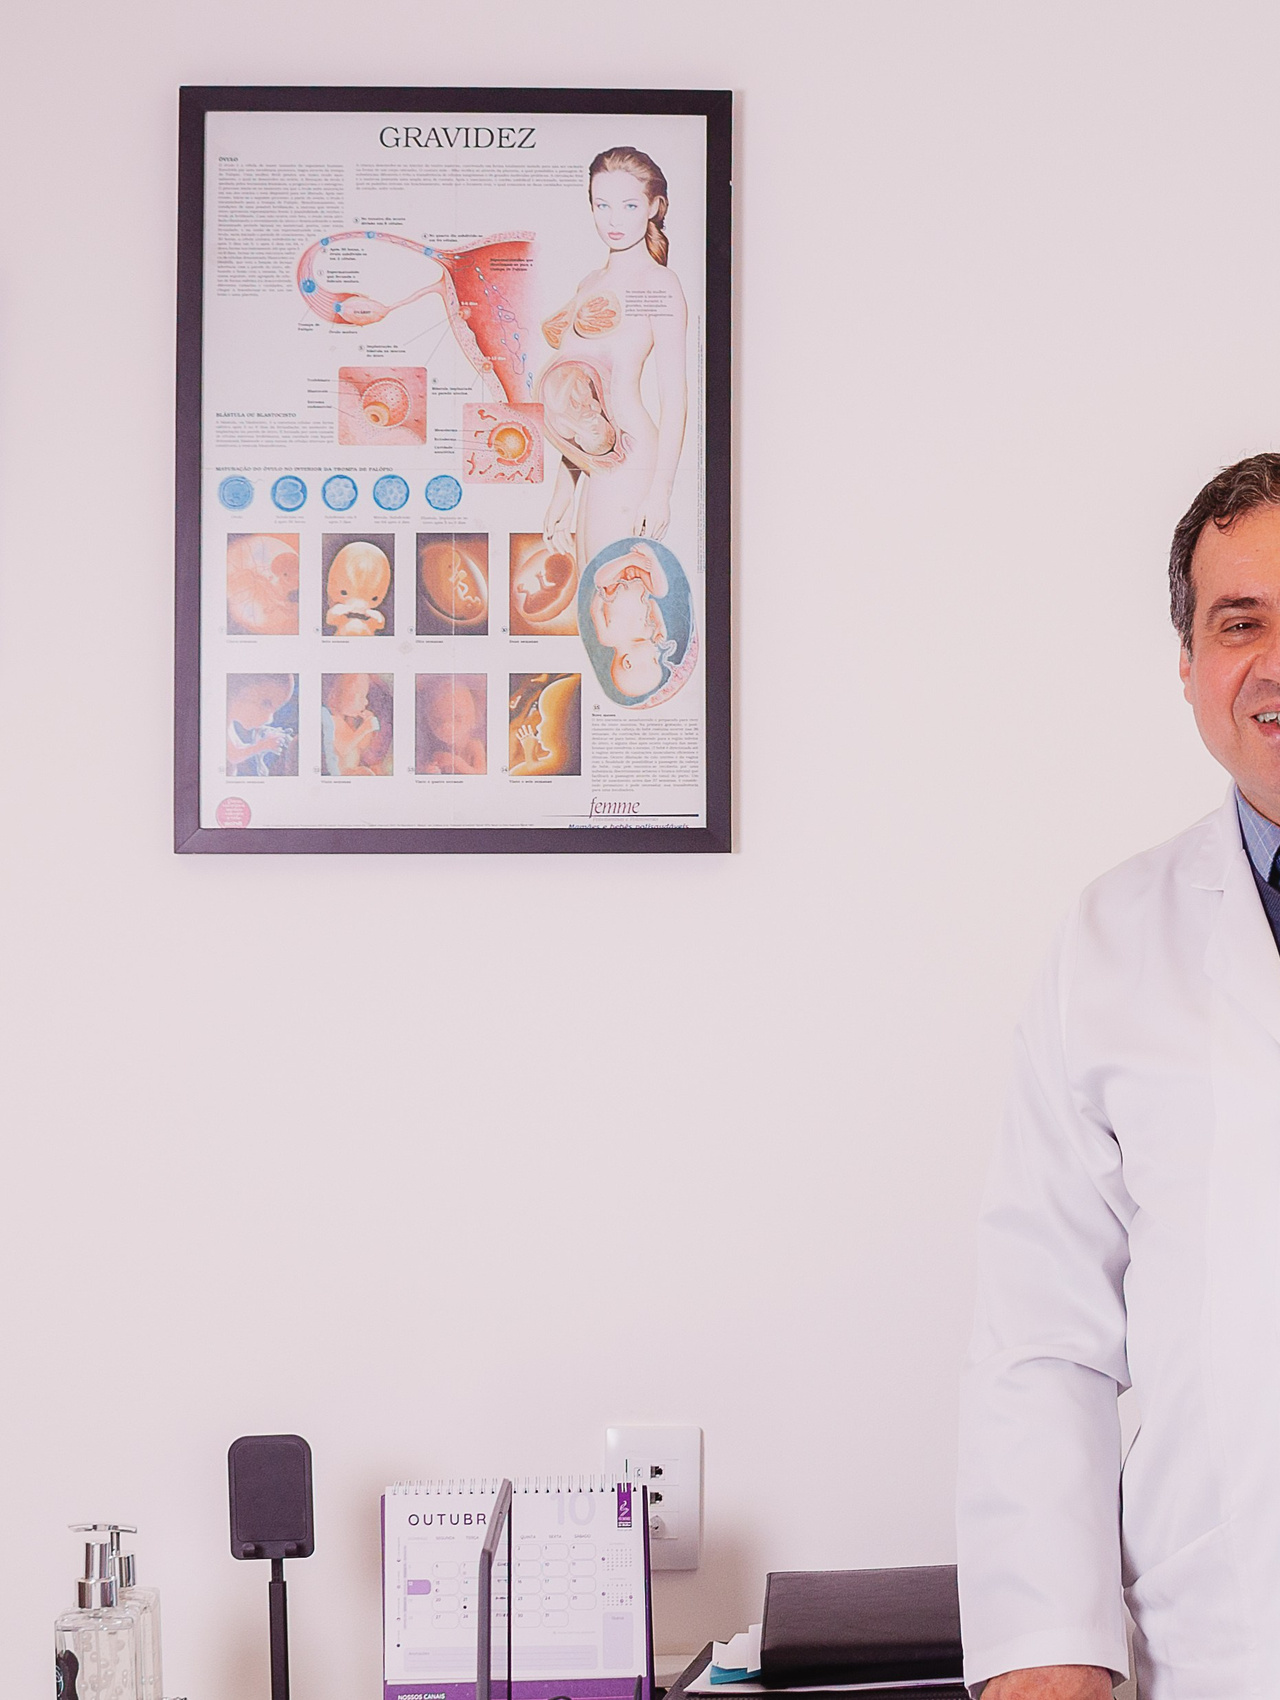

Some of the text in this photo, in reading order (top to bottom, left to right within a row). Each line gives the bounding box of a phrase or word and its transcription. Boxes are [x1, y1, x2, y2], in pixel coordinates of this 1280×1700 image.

[379, 126, 537, 149] GRAVIDEZ
[589, 797, 640, 818] femme
[551, 1490, 597, 1526] 10
[408, 1513, 487, 1526] OUTUBR
[424, 1692, 445, 1700] CANAIS
